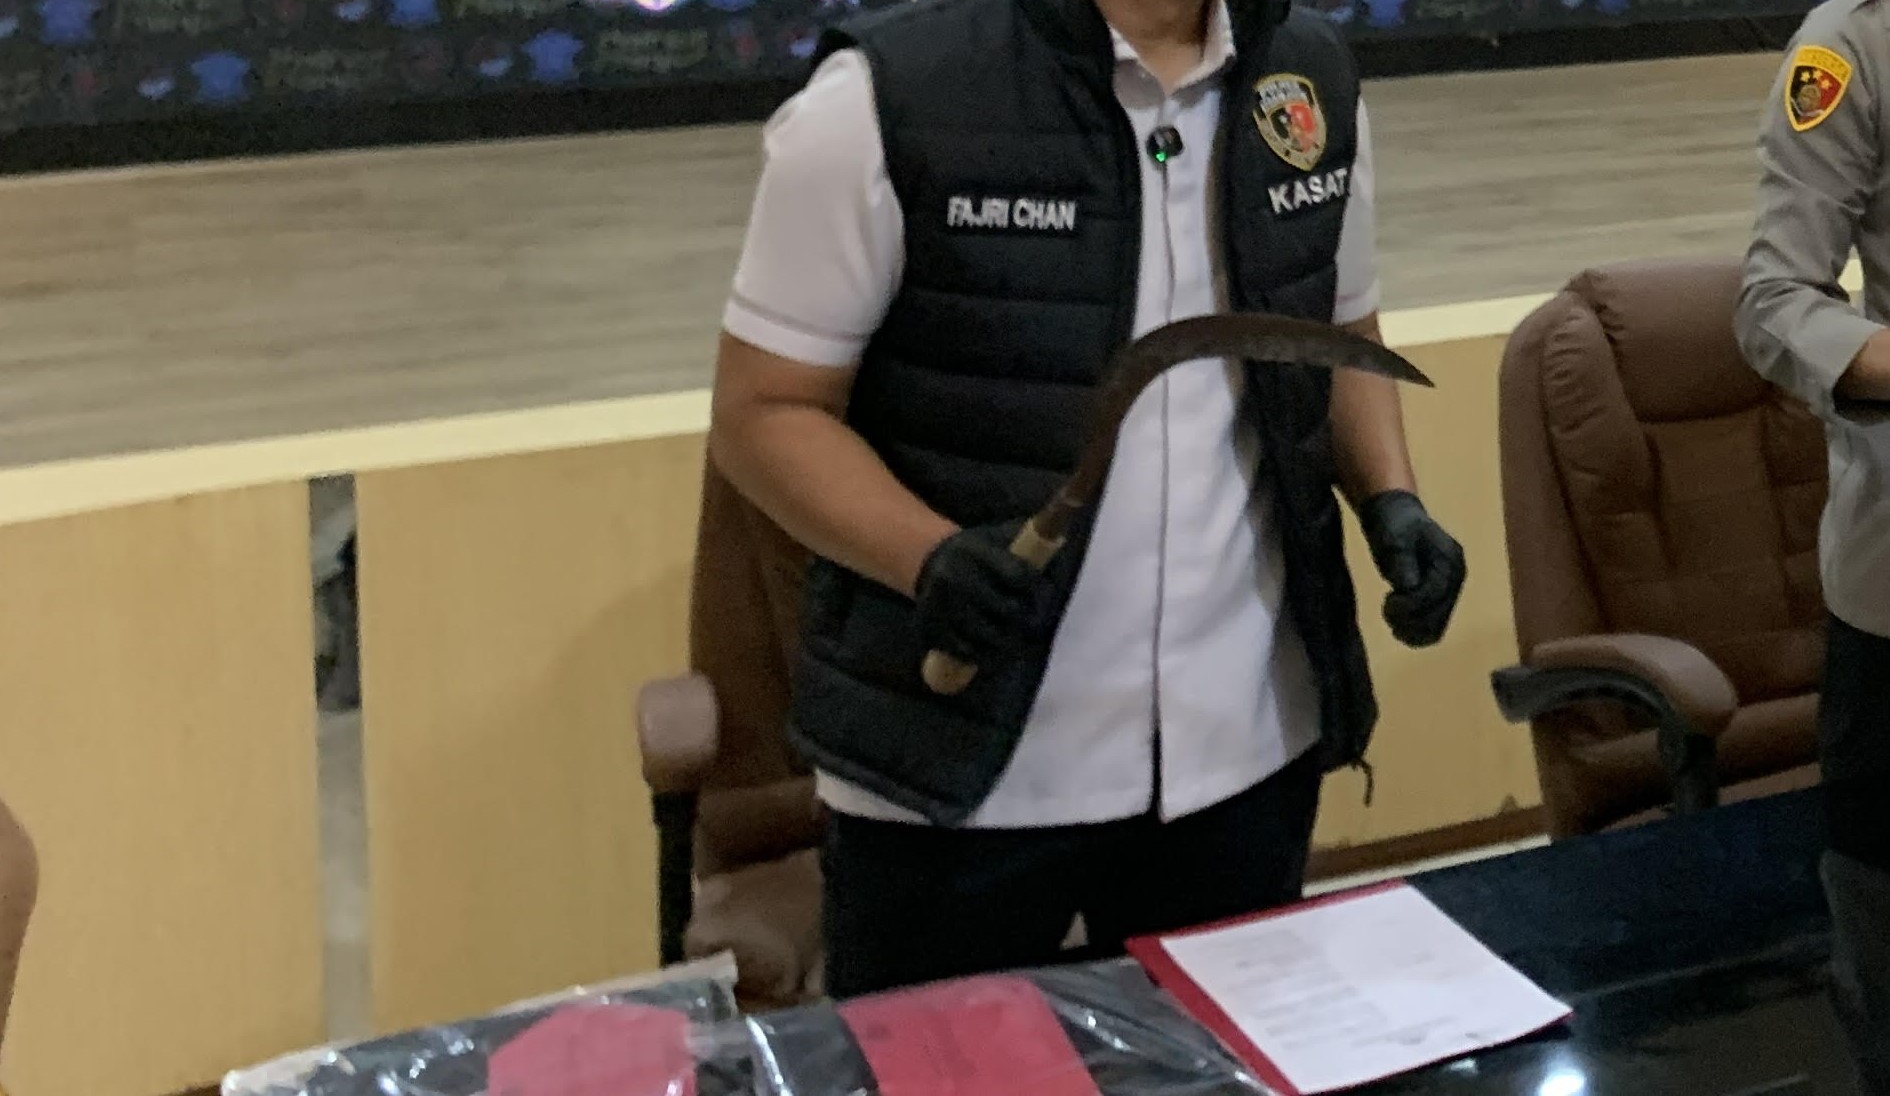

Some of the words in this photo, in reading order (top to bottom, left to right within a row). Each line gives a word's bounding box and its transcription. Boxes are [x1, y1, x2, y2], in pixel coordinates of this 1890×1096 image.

[1267, 166, 1348, 215] KASAT
[946, 195, 1010, 229] FAJRI
[1012, 197, 1077, 231] CHAN
